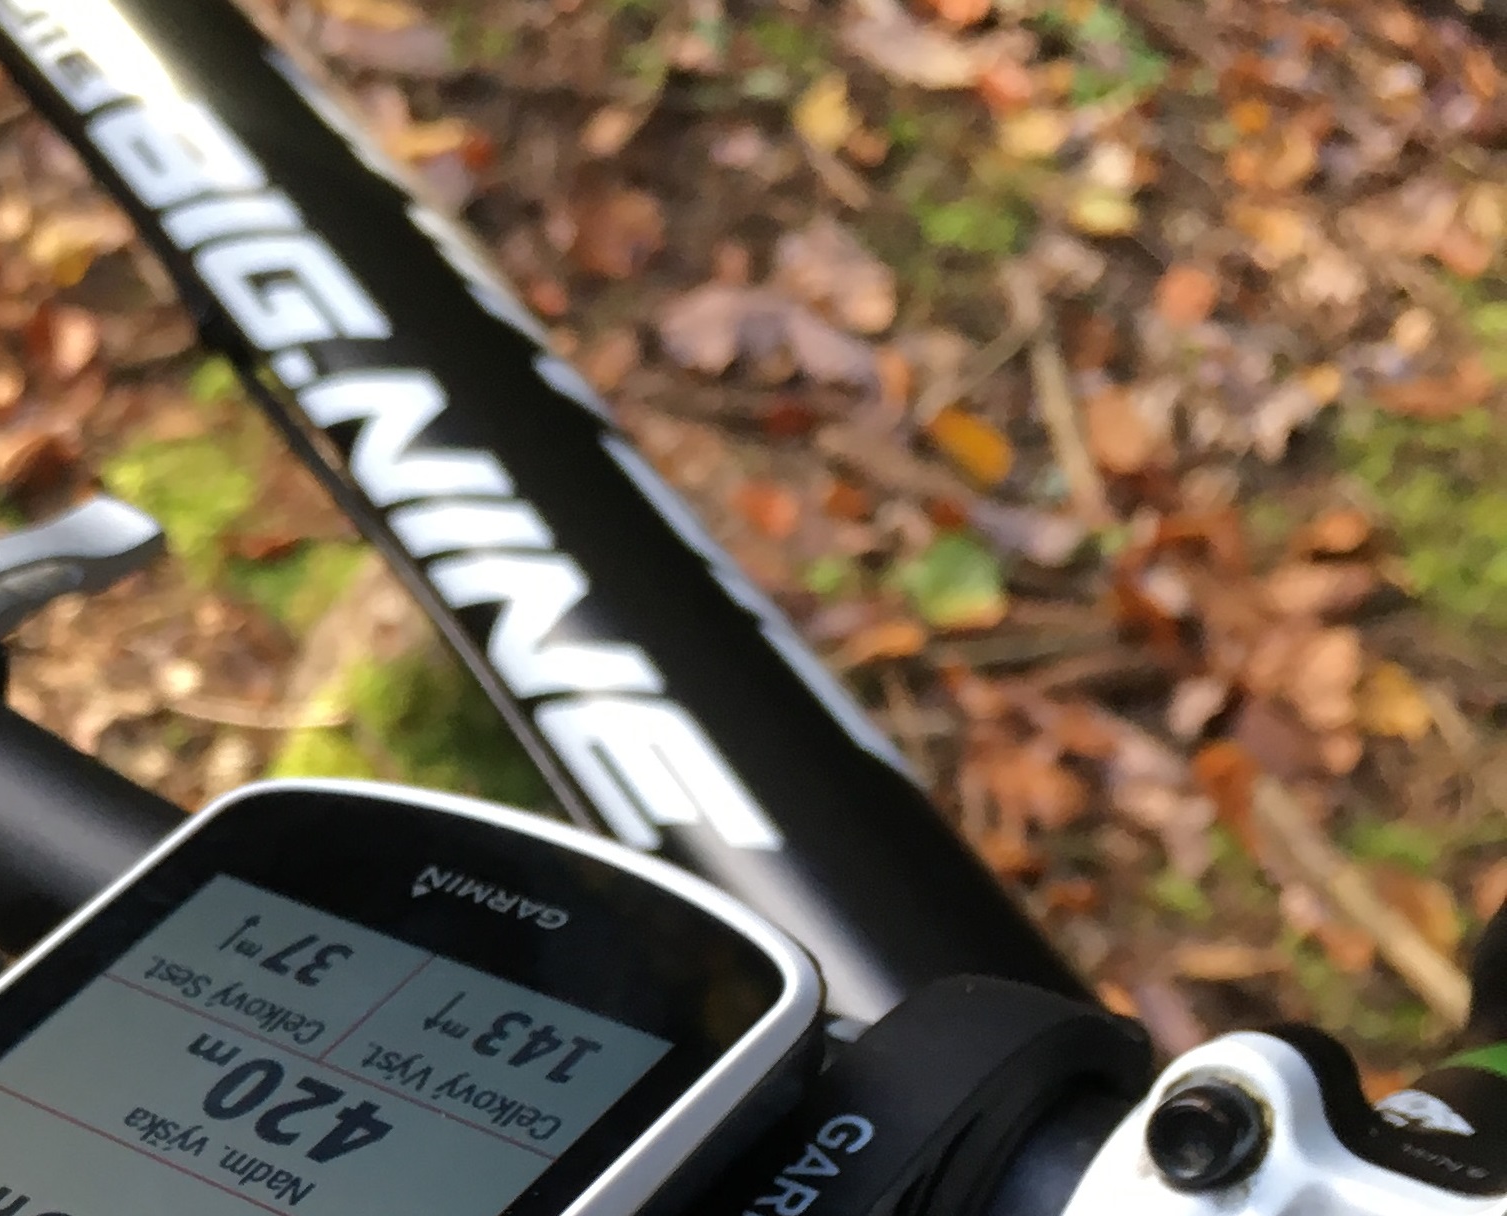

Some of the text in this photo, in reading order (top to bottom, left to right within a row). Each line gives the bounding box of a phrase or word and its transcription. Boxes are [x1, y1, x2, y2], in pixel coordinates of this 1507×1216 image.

[86, 97, 783, 850] BIG.NINE
[411, 865, 570, 930] GARMIN
[259, 933, 355, 986] 37
[203, 981, 326, 1045] Celkový
[472, 1011, 603, 1084] 143
[203, 1058, 394, 1164] 420
[431, 1071, 563, 1140] Celkový
[123, 1106, 317, 1206] Nadm. výška
